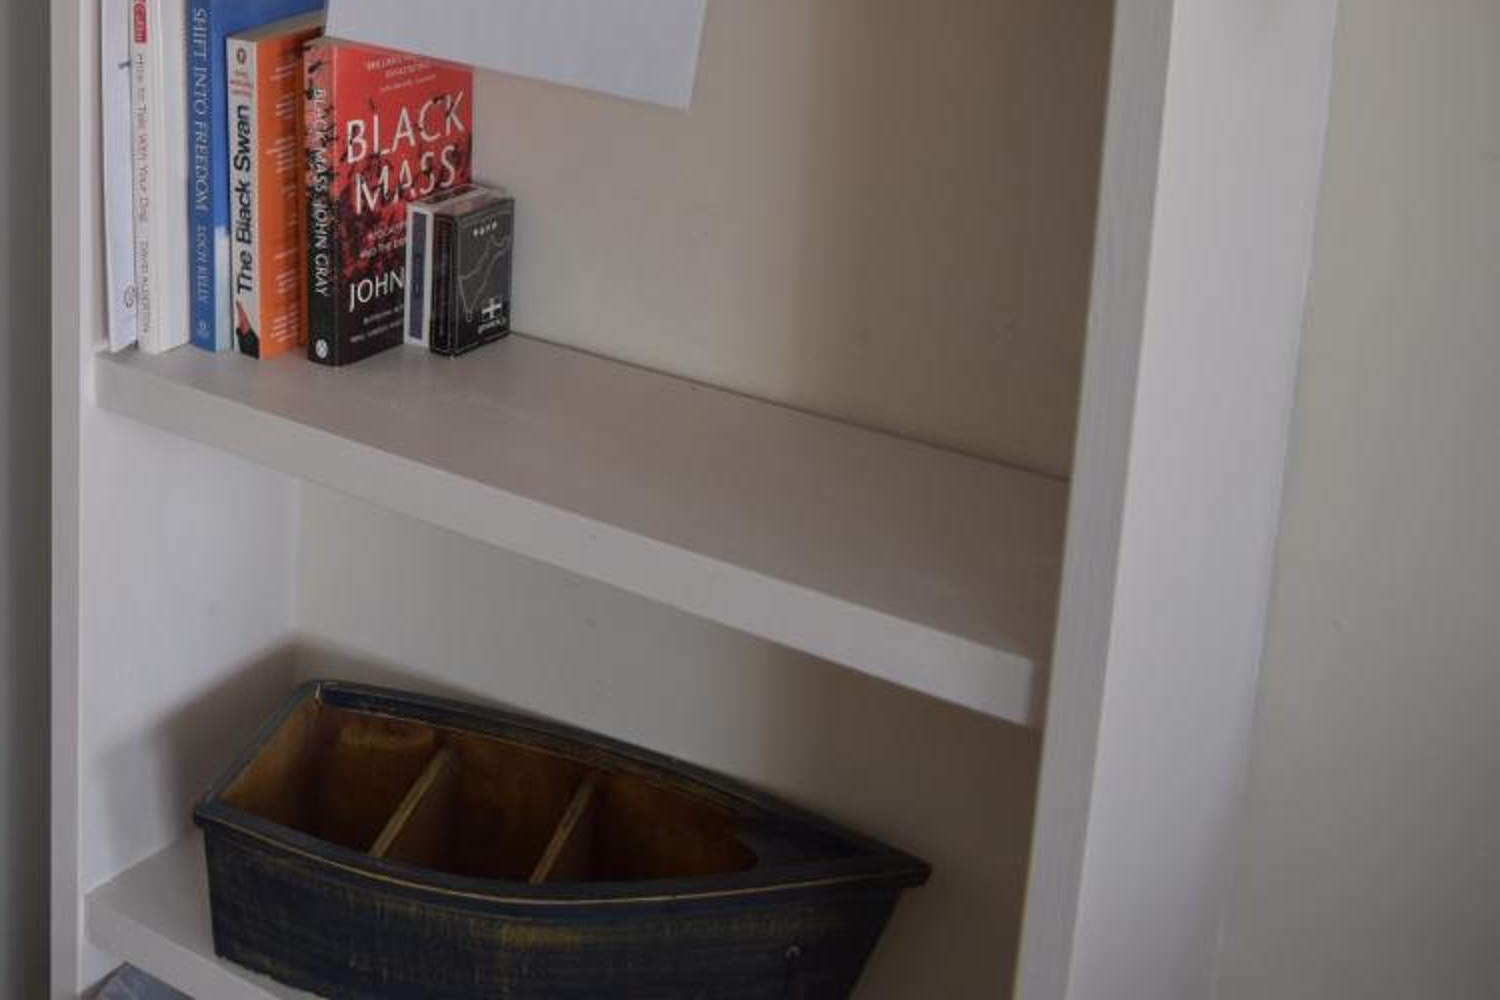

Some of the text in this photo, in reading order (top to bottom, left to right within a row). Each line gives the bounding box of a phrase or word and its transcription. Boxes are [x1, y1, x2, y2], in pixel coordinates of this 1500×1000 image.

[193, 7, 208, 62] SHIFT
[193, 66, 209, 115] INTO
[346, 89, 465, 164] BLACK
[194, 120, 210, 211] FREEDOM
[233, 104, 253, 295] The Black Swan
[312, 87, 332, 297] BLACK MASS JOHN GRAY
[355, 144, 456, 216] MASS
[349, 267, 405, 313] JOHN
